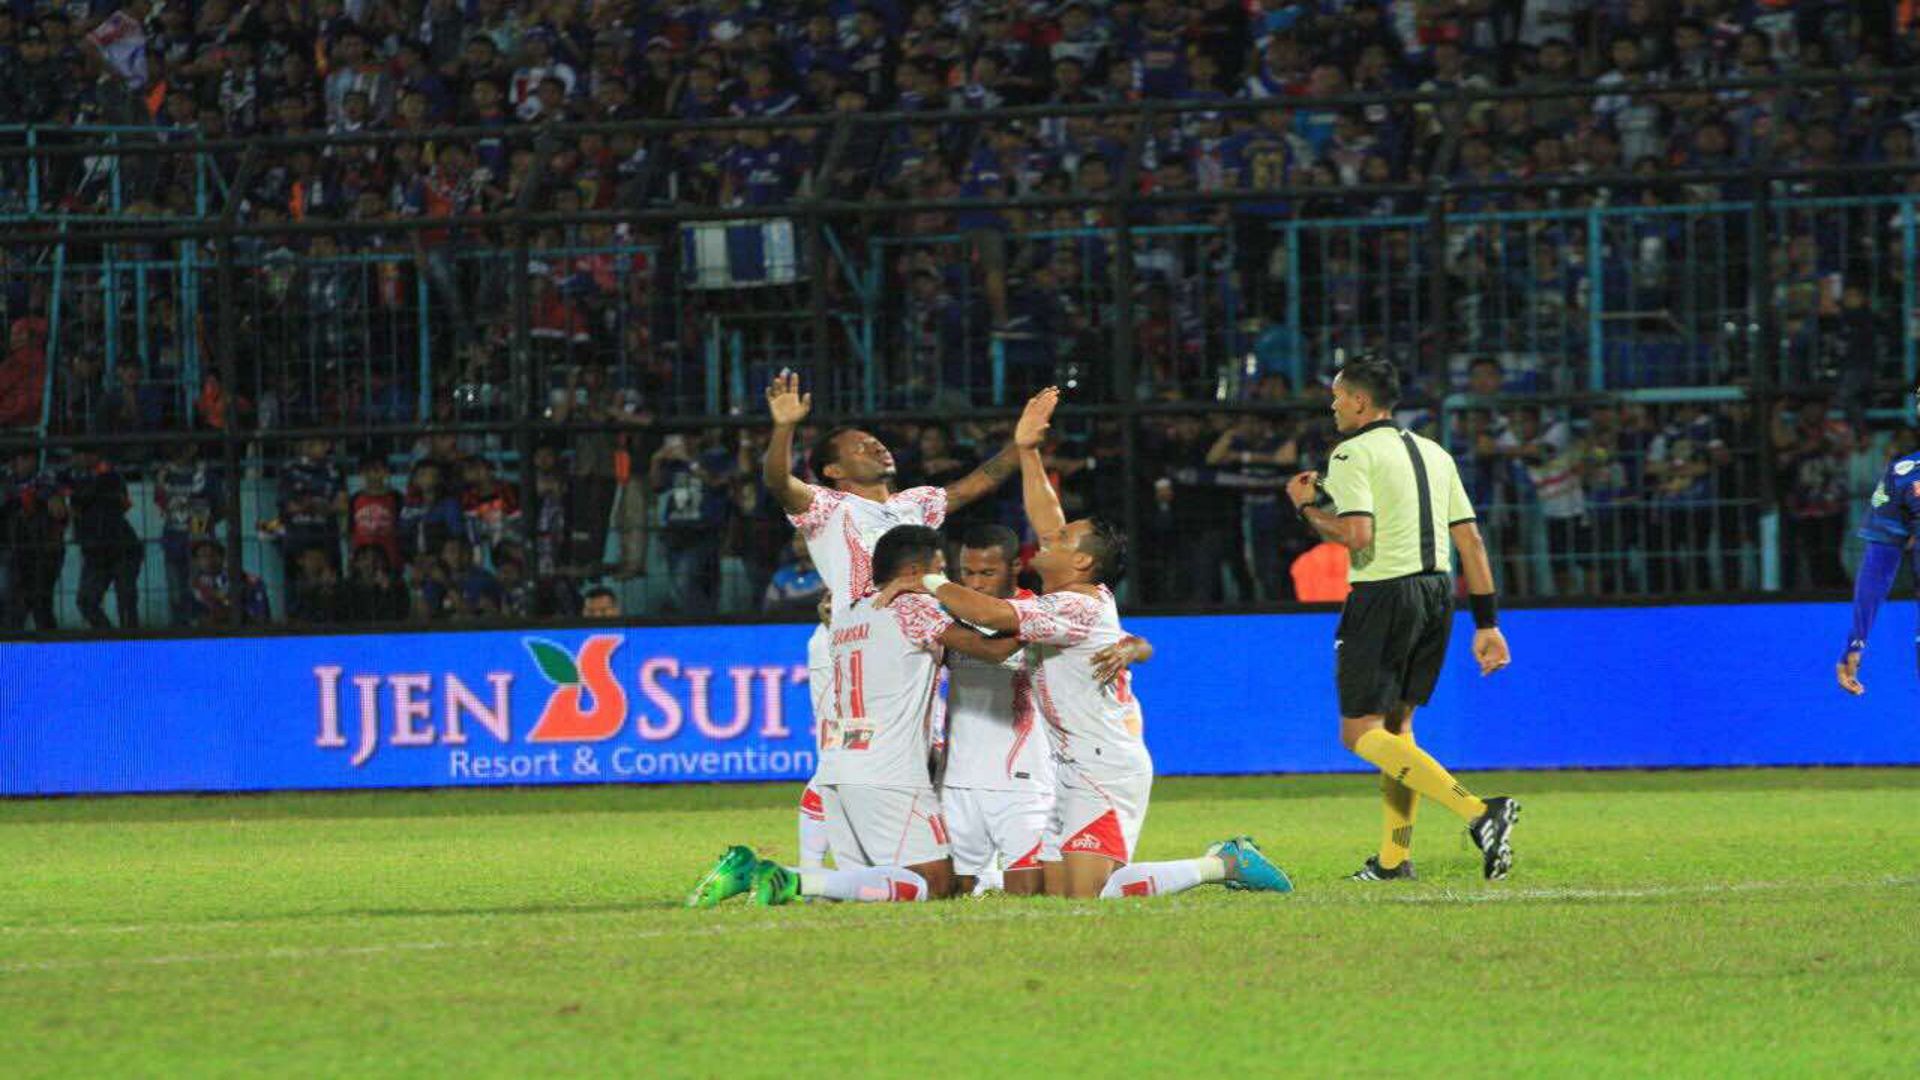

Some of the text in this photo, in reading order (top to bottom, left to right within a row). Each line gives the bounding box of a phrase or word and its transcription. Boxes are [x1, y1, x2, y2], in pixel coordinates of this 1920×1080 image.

[313, 656, 816, 766] IJEN SUI
[450, 745, 813, 778] Resort & Convention
